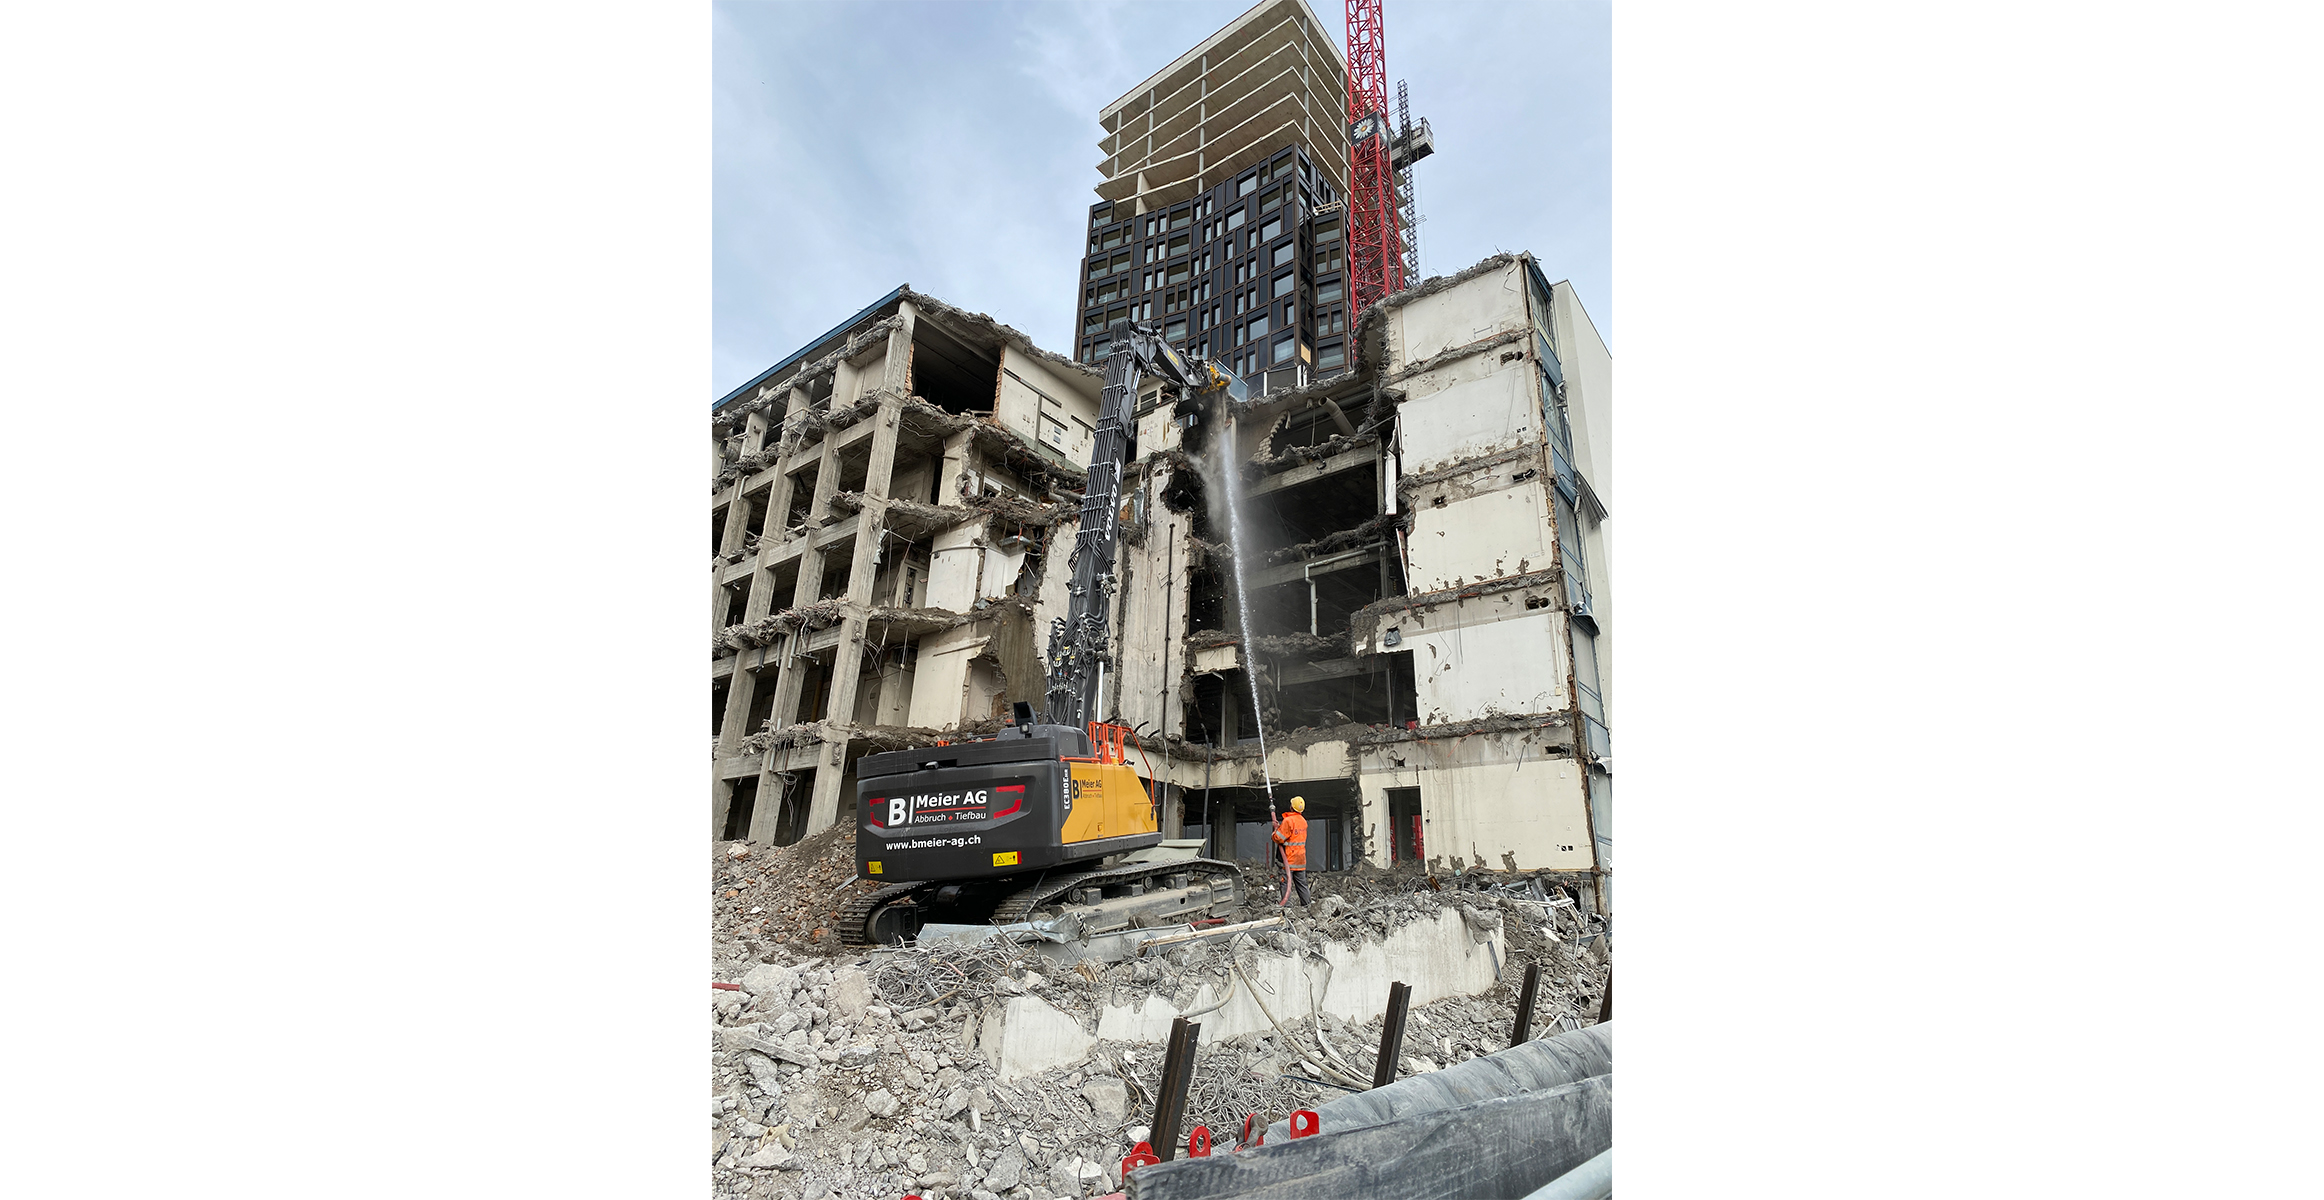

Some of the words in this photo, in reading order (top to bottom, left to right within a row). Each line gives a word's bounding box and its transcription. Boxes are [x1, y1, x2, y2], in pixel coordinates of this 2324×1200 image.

[1105, 484, 1117, 541] VOLVO
[1072, 779, 1080, 799] B
[1081, 779, 1095, 789] Meier
[1095, 779, 1102, 788] AG
[888, 798, 907, 827] B
[916, 793, 960, 809] Meier
[963, 790, 988, 805] AG
[914, 813, 946, 824] Abbruch
[955, 811, 986, 821] Tiefbau
[886, 834, 981, 851] www.bmeier-ag.ch
